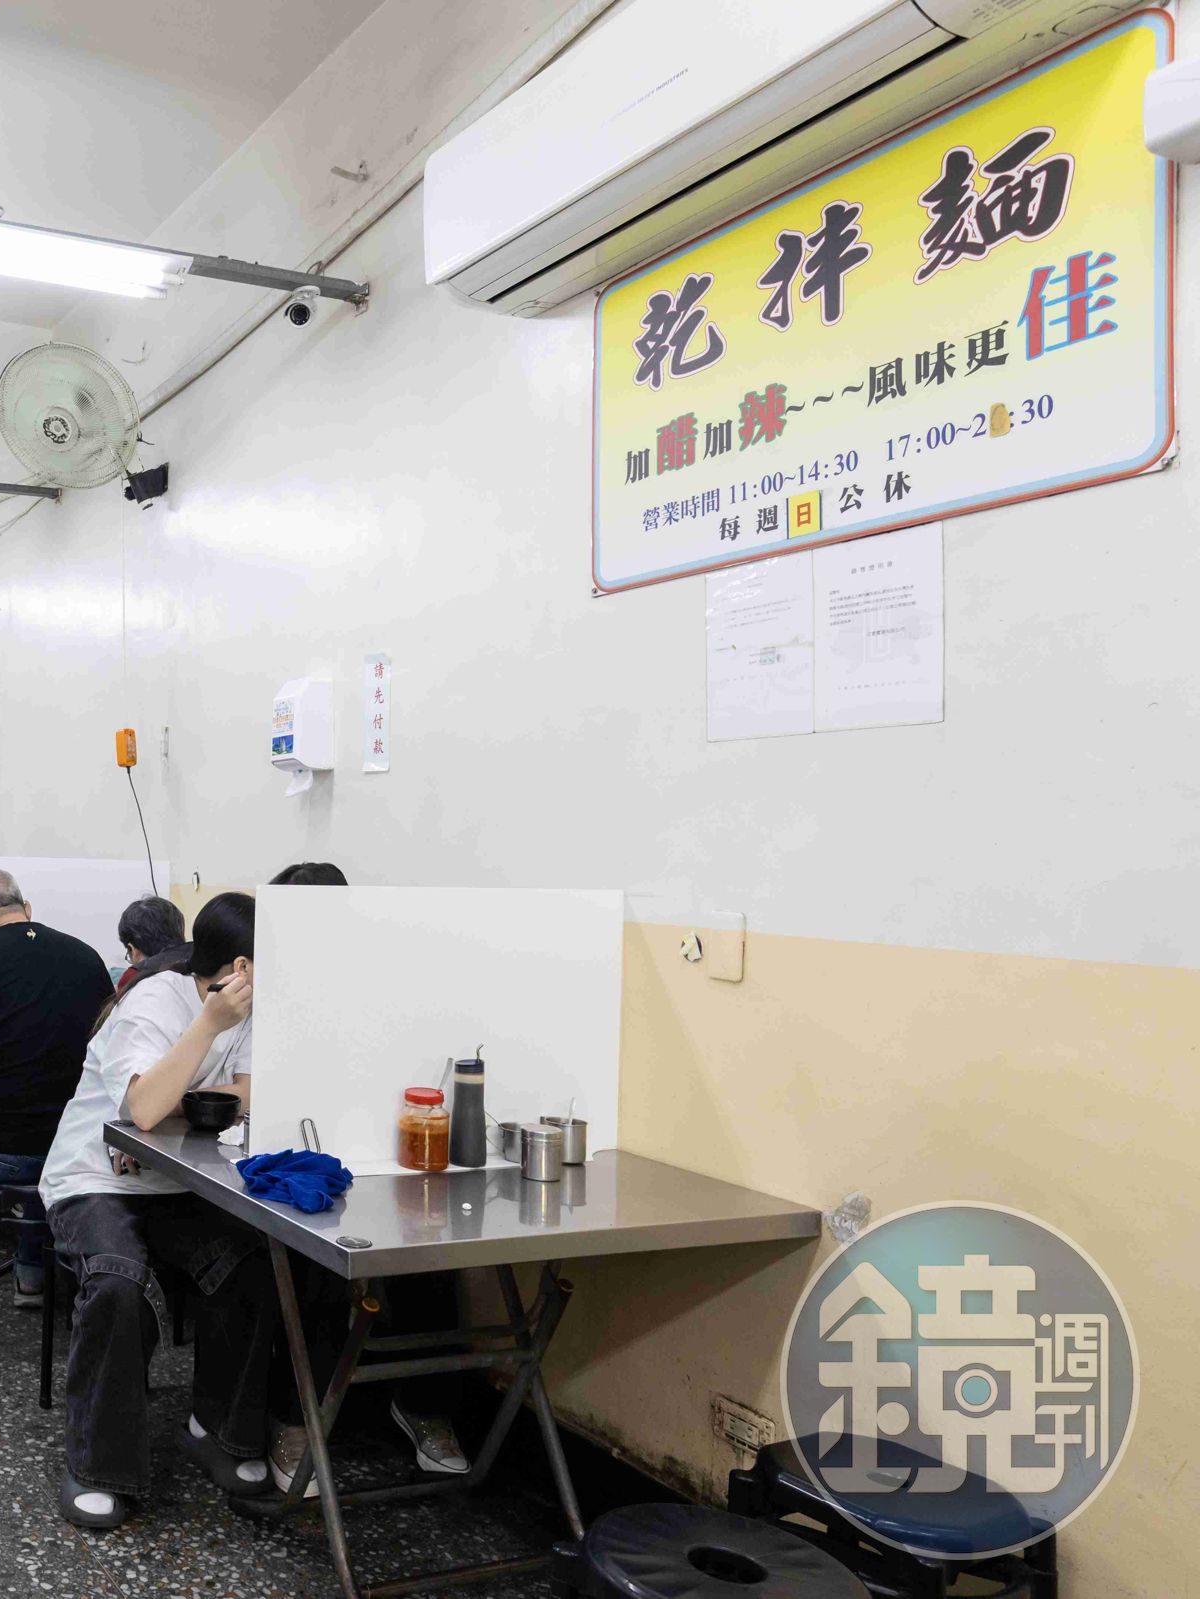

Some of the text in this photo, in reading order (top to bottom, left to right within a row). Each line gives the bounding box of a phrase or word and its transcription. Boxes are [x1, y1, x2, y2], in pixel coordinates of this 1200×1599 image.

[643, 393, 1054, 533] 營業時間 11:00~14:30 17:00~2:30
[372, 661, 385, 754] 請先付款
